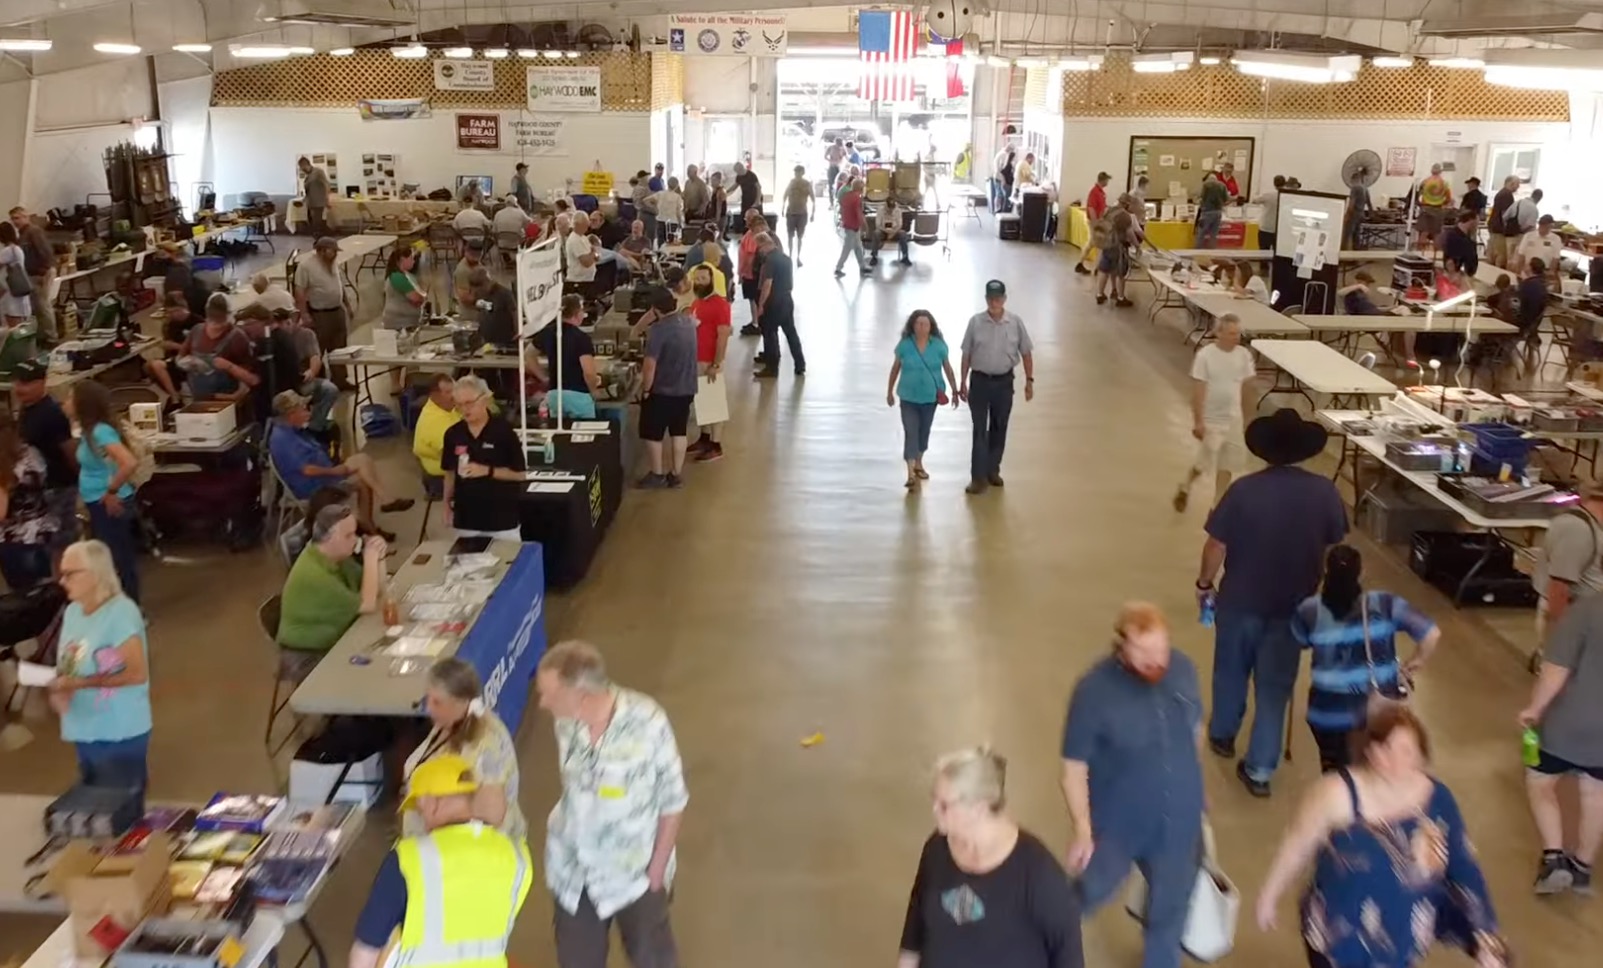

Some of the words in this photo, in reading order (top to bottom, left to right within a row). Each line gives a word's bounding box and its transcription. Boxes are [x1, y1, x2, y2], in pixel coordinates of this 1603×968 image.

[676, 15, 697, 24] Salute
[699, 16, 707, 24] to
[707, 16, 716, 24] all
[717, 16, 729, 25] the
[729, 16, 753, 26] Military
[539, 85, 579, 97] HAYWOOD
[579, 85, 597, 97] EMC
[469, 119, 496, 129] FARM
[508, 121, 538, 129] HAYWOOD
[460, 128, 496, 137] BUREAU
